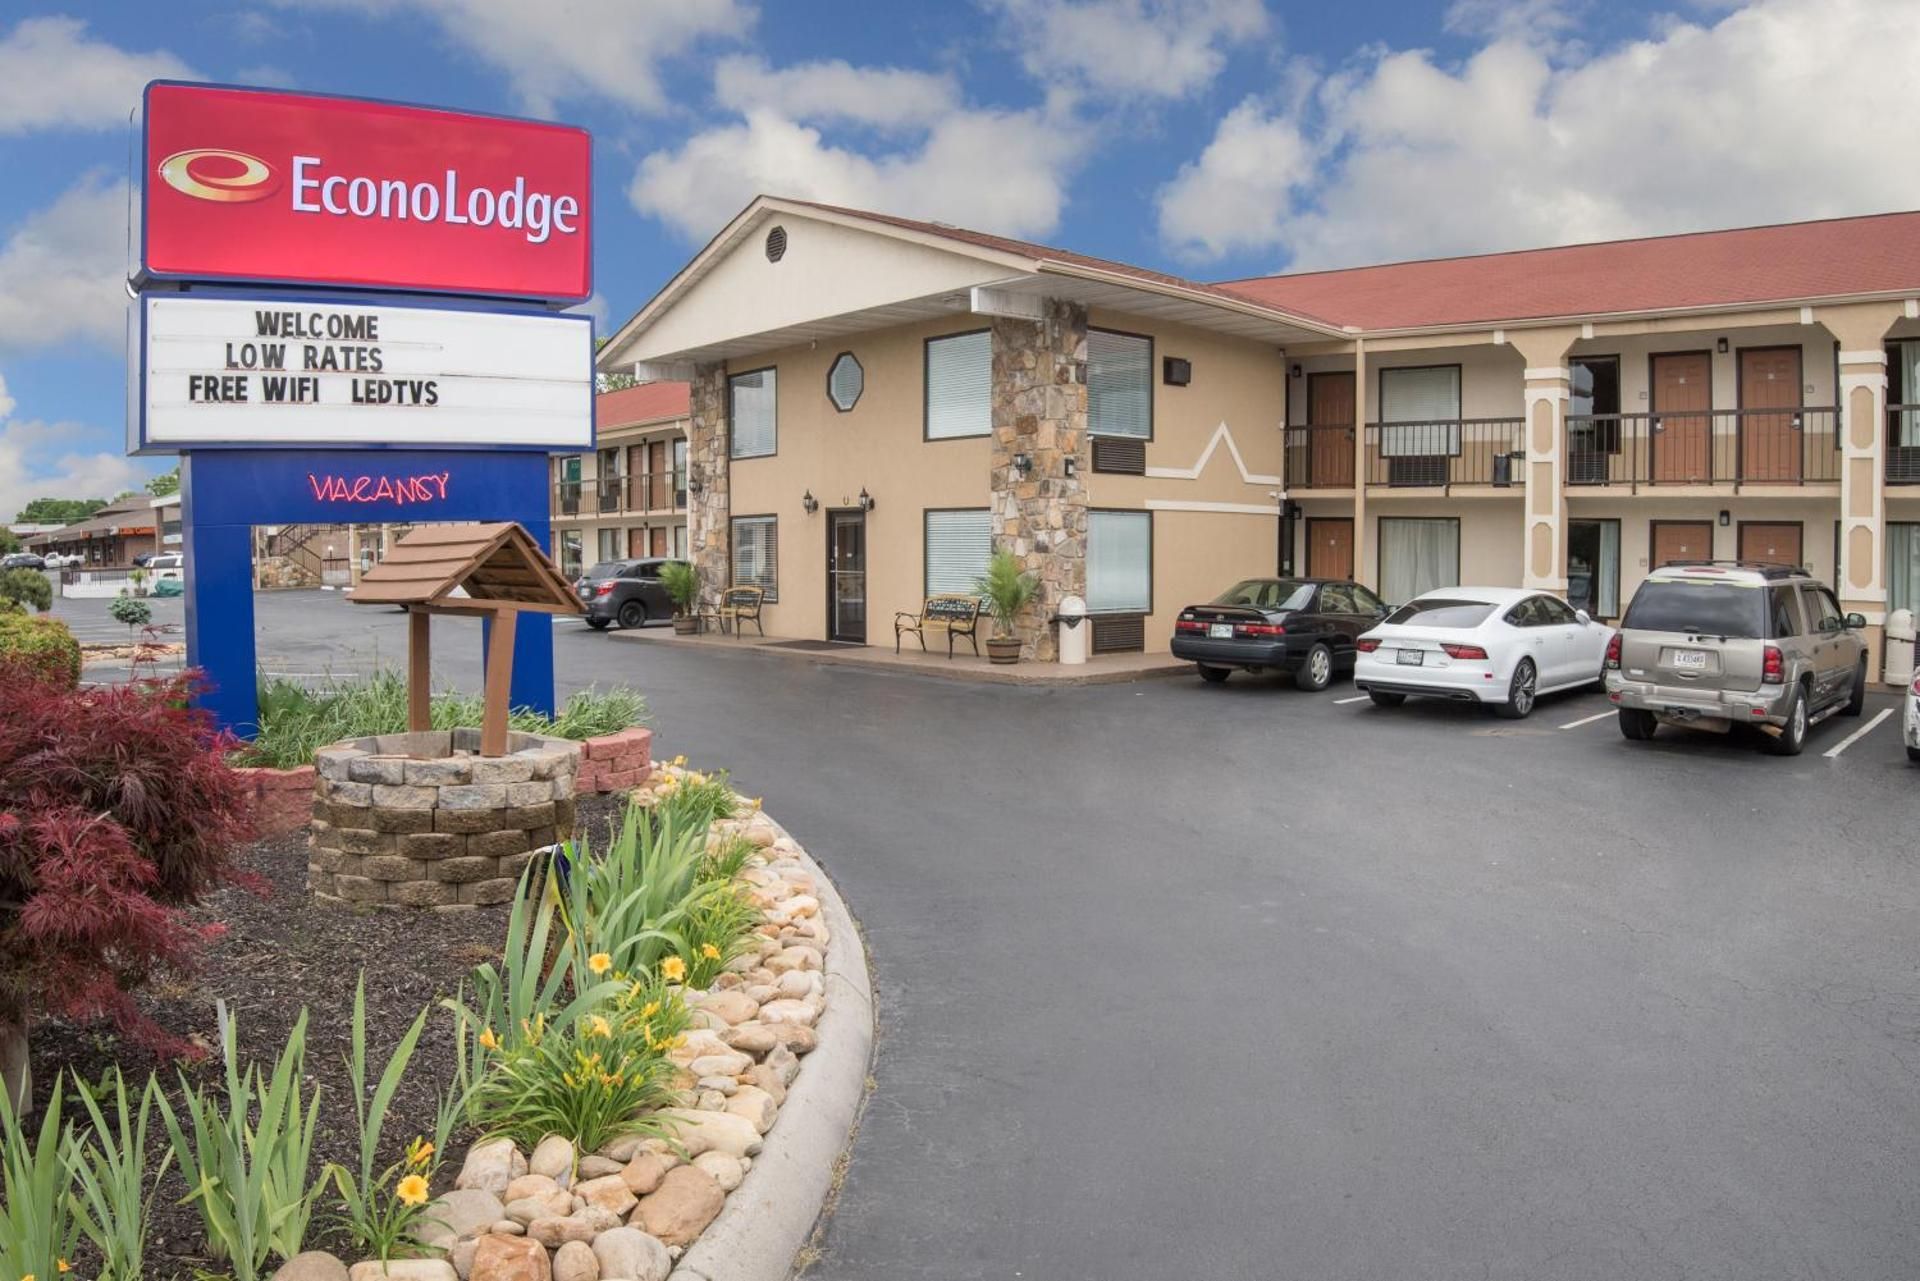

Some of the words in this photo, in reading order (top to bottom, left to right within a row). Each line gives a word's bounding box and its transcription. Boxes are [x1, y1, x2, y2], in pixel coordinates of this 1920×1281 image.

[292, 155, 579, 243] EconoLodge
[256, 311, 379, 340] WELCOME
[226, 342, 286, 369] LOW
[303, 345, 383, 371] RATES
[189, 375, 248, 401] FREE
[262, 377, 319, 403] WIFI
[351, 378, 439, 405] LEDTVS
[308, 472, 449, 504] VACANCY
